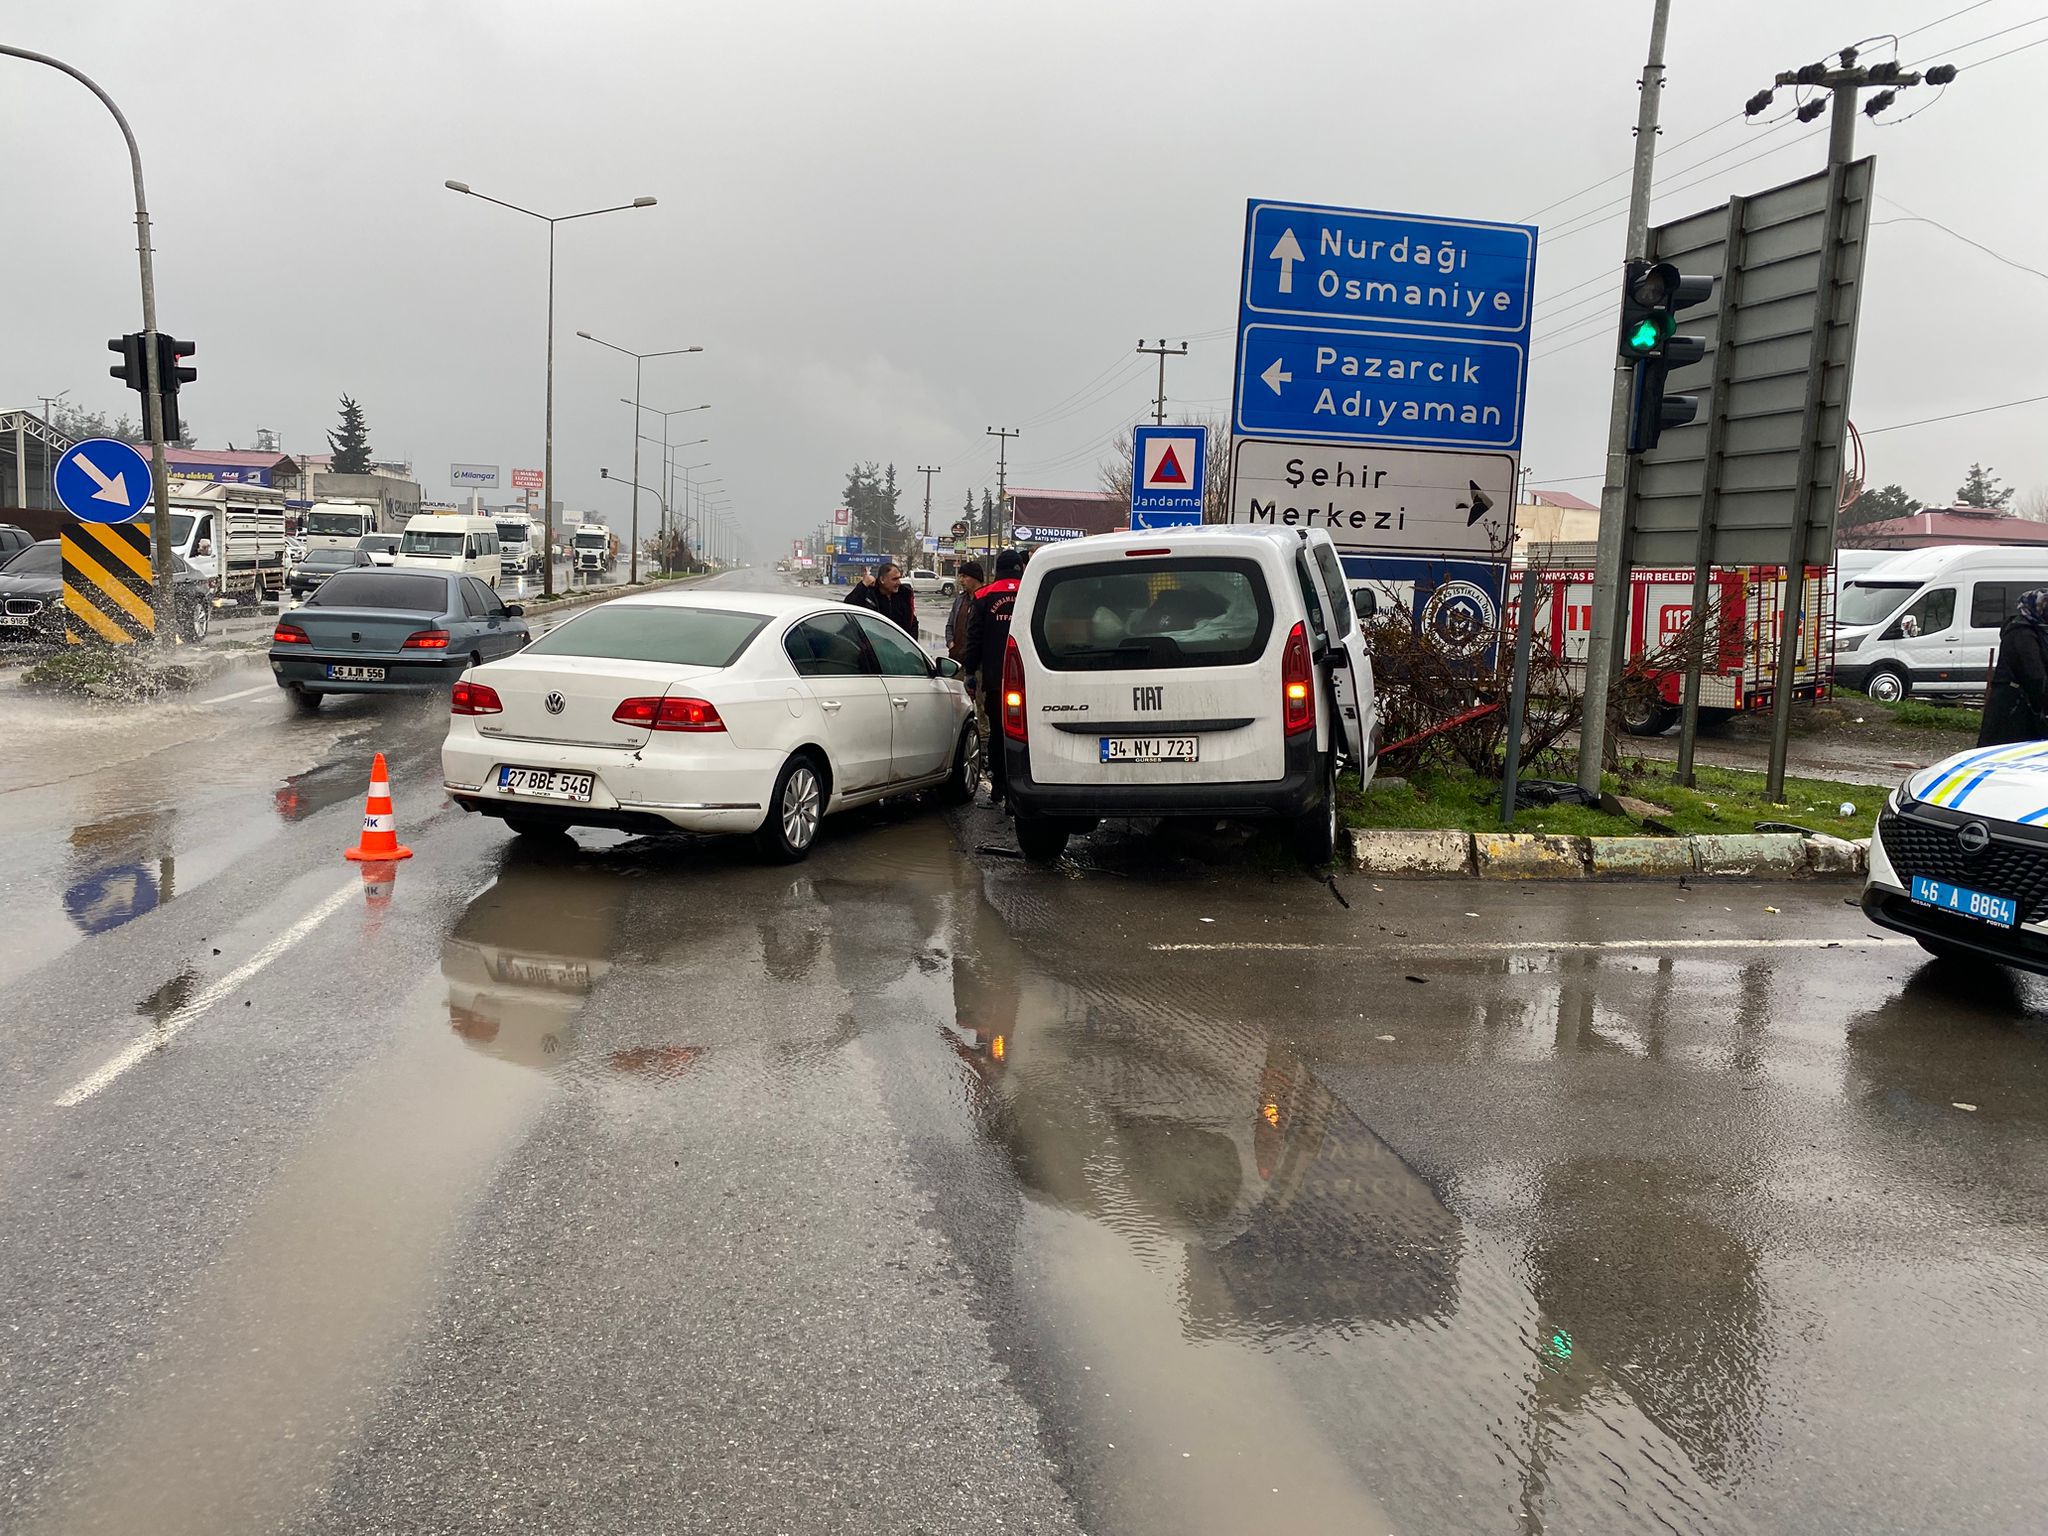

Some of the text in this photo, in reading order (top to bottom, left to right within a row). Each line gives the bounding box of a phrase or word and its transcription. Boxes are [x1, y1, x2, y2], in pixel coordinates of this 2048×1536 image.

[1320, 228, 1466, 273] Nurdağı
[1317, 269, 1511, 317] Osmaniye
[1315, 346, 1481, 384] Pazarcık
[1312, 387, 1502, 426] Adıyaman
[460, 471, 496, 481] Milangaz
[1285, 458, 1388, 490] Şehir
[1134, 495, 1201, 506] Jandarma
[1250, 498, 1405, 531] Merkezi
[1035, 528, 1084, 538] DONDURMA
[367, 668, 384, 679] 556
[1042, 704, 1089, 712] DOBLO
[1132, 686, 1164, 711] FIAT
[1110, 740, 1194, 756] 34 NYJ 723
[508, 771, 589, 794] 27 BBE 546
[1911, 899, 1931, 908] NISSAN
[1920, 880, 1939, 901] 46
[1950, 888, 1958, 908] A
[1970, 893, 2009, 921] 8864
